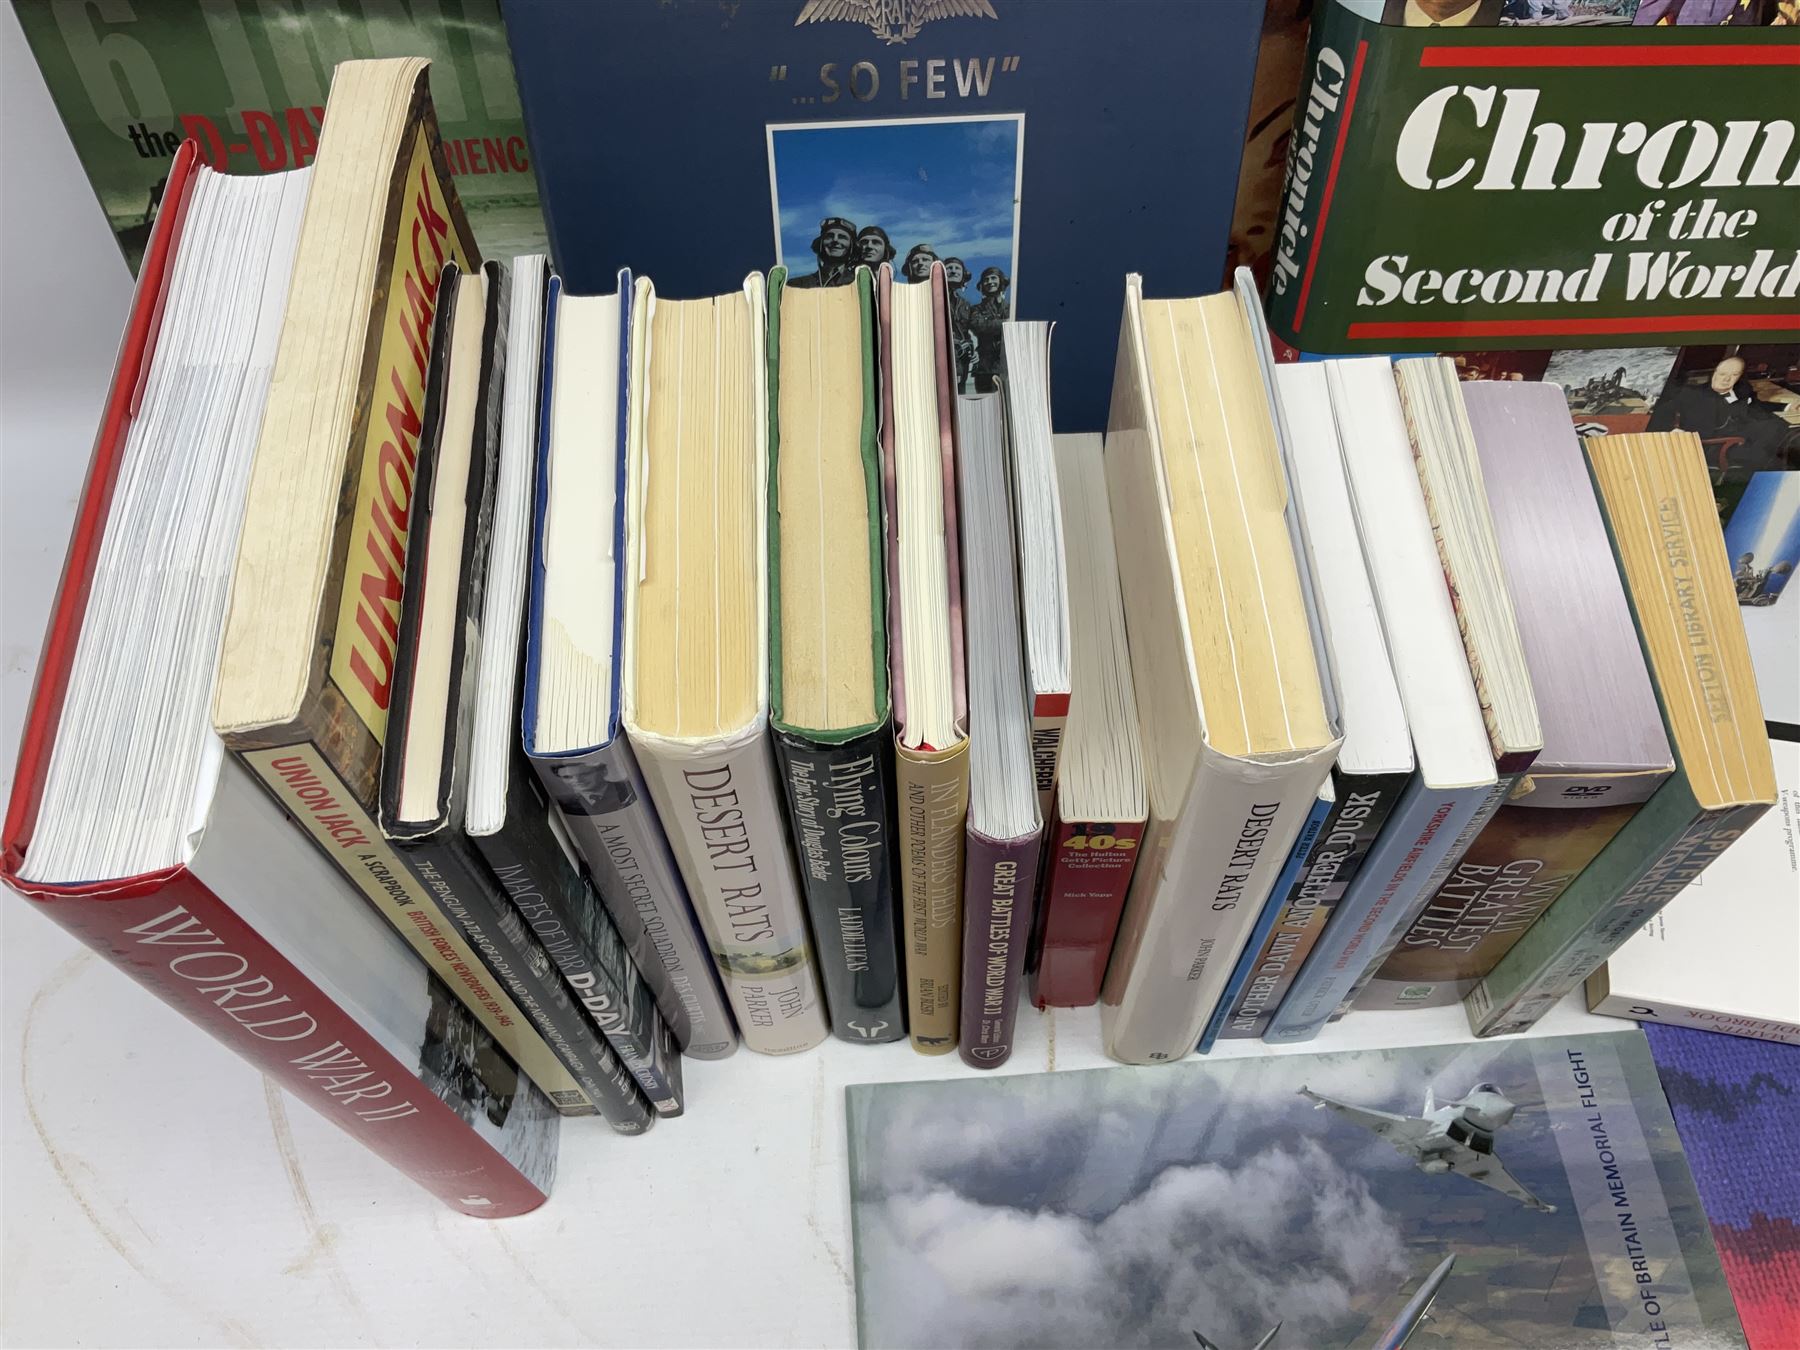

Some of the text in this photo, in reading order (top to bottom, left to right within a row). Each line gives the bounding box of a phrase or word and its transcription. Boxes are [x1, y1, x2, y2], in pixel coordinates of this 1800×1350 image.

[128, 123, 181, 158] the
[1396, 85, 1800, 190] Chron
[1273, 46, 1346, 296] Chronicle
[1603, 198, 1758, 242] of the
[1356, 249, 1800, 306] Second World
[349, 365, 422, 711] UNION
[1675, 575, 1707, 646] LIBRARY
[790, 760, 814, 777] The
[792, 775, 816, 792] Epic
[796, 789, 820, 819] Story
[909, 782, 925, 806] AND
[1564, 785, 1612, 793] DVD
[271, 756, 341, 811] UNION
[315, 813, 371, 848] JACK
[365, 861, 415, 906] SCRAPBOOK
[598, 823, 620, 834] A
[822, 754, 882, 883] Flying Colours
[910, 806, 926, 834] OTHER
[1414, 801, 1456, 846] YORKSHIRE
[604, 836, 639, 874] MOST
[683, 764, 774, 943] DESERT RATS
[802, 823, 829, 862] Douglas
[911, 836, 927, 869] POEMS
[930, 778, 960, 929] IN FLANDERS FIELDS
[1063, 835, 1137, 849] 40s
[1212, 802, 1280, 911] DESERT RATS
[810, 857, 832, 881] Bader
[911, 868, 926, 880] OF
[993, 862, 1017, 898] GREAT
[1395, 846, 1424, 884] AIRFIELDS
[1616, 828, 1713, 906] WOMEN
[1648, 829, 1740, 903] SPITFIRE
[493, 864, 552, 924] IMAGES
[623, 874, 658, 918] SECRET
[911, 879, 927, 897] THE
[1405, 861, 1502, 949] BATTLES
[1440, 859, 1544, 953] GREATEST
[415, 860, 441, 881] THE
[431, 880, 471, 919] PENGUIN
[460, 919, 490, 944] ATLAS
[506, 977, 528, 994] AND
[912, 896, 927, 920] FIRST
[990, 900, 1016, 944] BATTLES
[1232, 791, 1382, 1031] ANOTHER DAWN ANOTHER DUSK
[1361, 907, 1383, 932] SECOND
[532, 920, 566, 943] OF
[642, 916, 684, 972] SQUADRON
[913, 918, 928, 945] WORLD
[990, 943, 1008, 957] OF
[1197, 939, 1216, 958] JOHN
[406, 911, 440, 939] BRITISH
[451, 960, 492, 1005] NEWSPAPERS
[546, 937, 585, 975] WAR
[985, 956, 1009, 991] WORLD
[122, 905, 419, 1122] WORLD WAR II
[566, 971, 631, 1035] D-DAY
[741, 985, 774, 1028] PARKER
[769, 985, 804, 1019] JOHN
[983, 1007, 1002, 1015] II
[985, 988, 1003, 1007] WAR
[1712, 1024, 1788, 1040] MARTIN
[1567, 1049, 1600, 1108] FLIGHT
[1589, 1112, 1629, 1206] MEMORIAL
[1617, 1212, 1652, 1285] BRITAIN
[1640, 1290, 1660, 1315] OF
